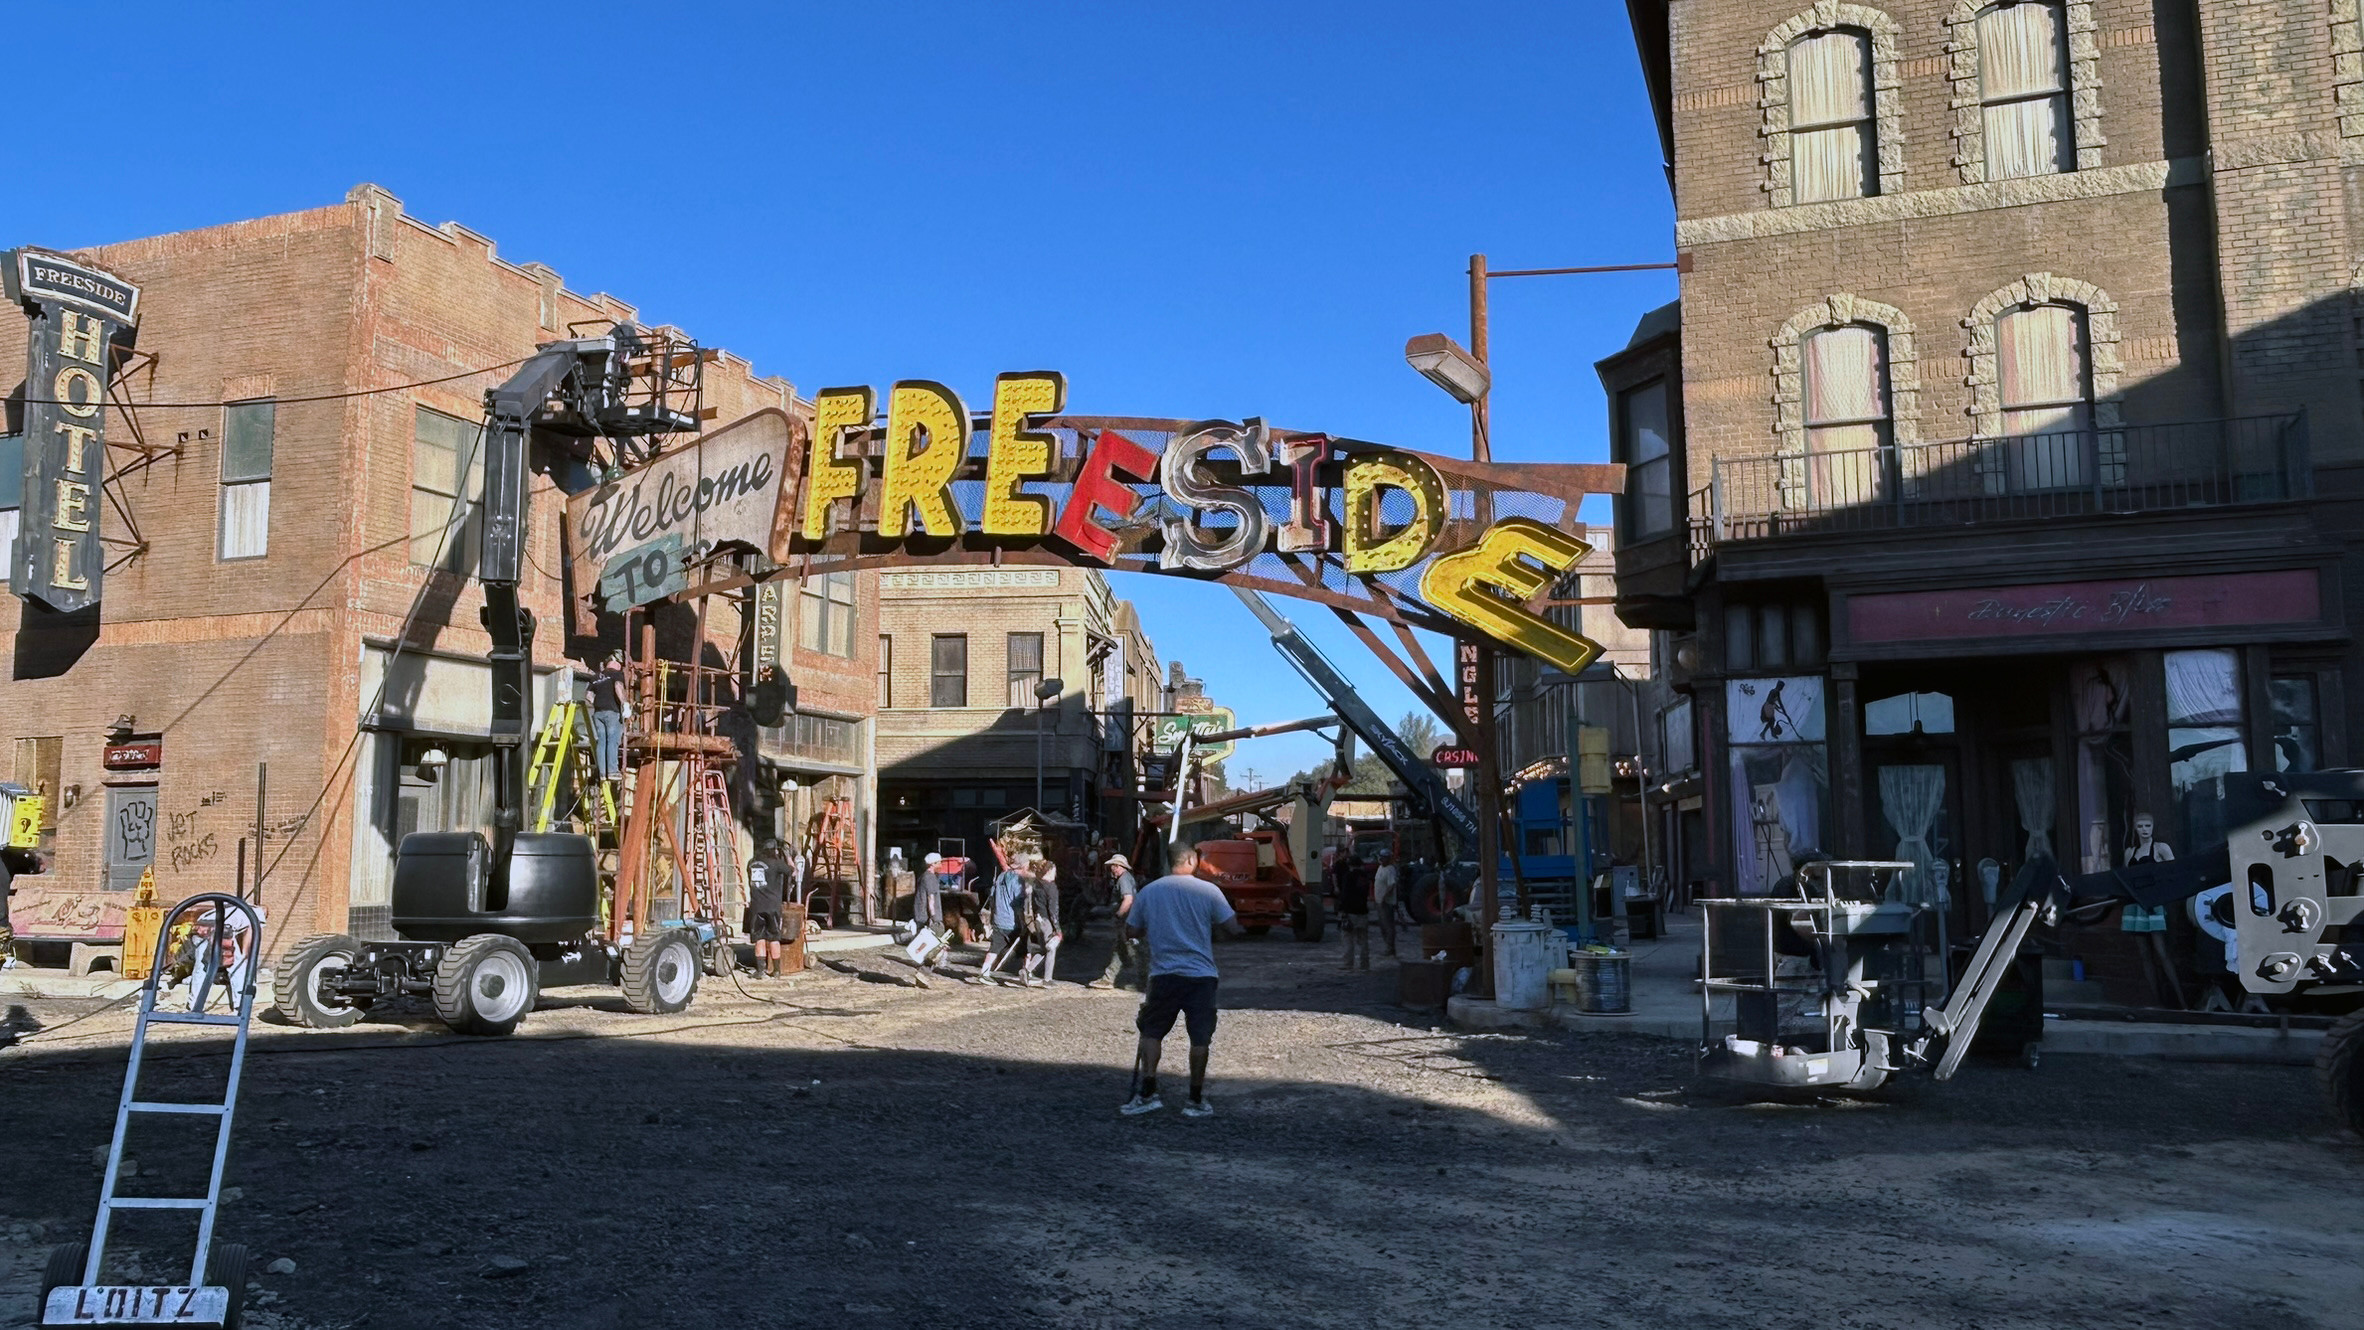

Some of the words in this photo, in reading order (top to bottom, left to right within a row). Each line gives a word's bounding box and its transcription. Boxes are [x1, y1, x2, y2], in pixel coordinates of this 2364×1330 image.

[34, 266, 127, 307] FREESIDE
[50, 306, 106, 592] HOTEL
[579, 452, 774, 560] Welcome
[800, 370, 1607, 677] FREESIDE
[613, 545, 670, 604] TO
[171, 832, 218, 874] ROCKS
